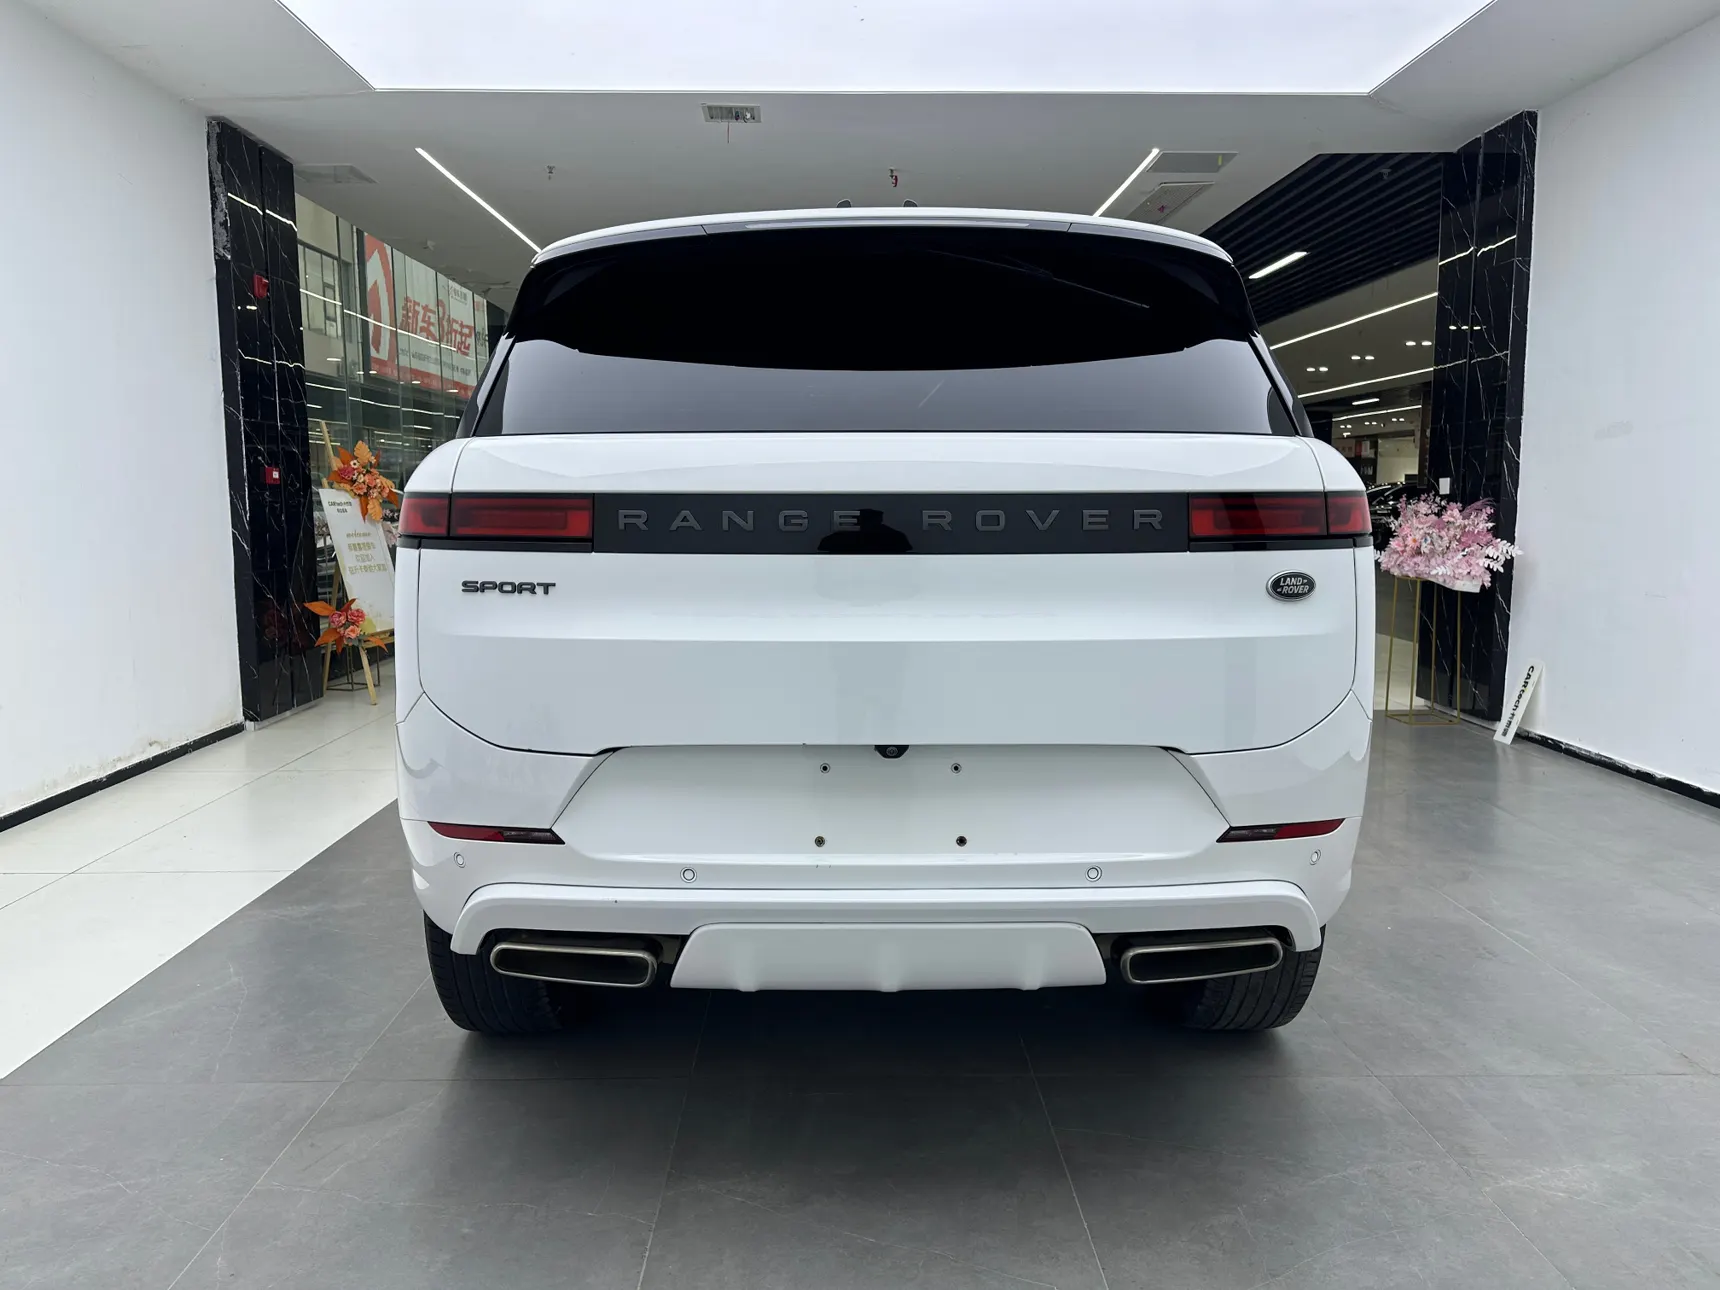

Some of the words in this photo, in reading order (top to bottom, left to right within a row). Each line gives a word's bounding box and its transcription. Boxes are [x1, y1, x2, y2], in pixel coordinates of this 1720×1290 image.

[618, 509, 862, 532] RANGE
[922, 509, 1163, 532] ROVER
[1279, 577, 1303, 586] LAND
[461, 580, 556, 596] SPORT
[1281, 585, 1310, 594] ROVER
